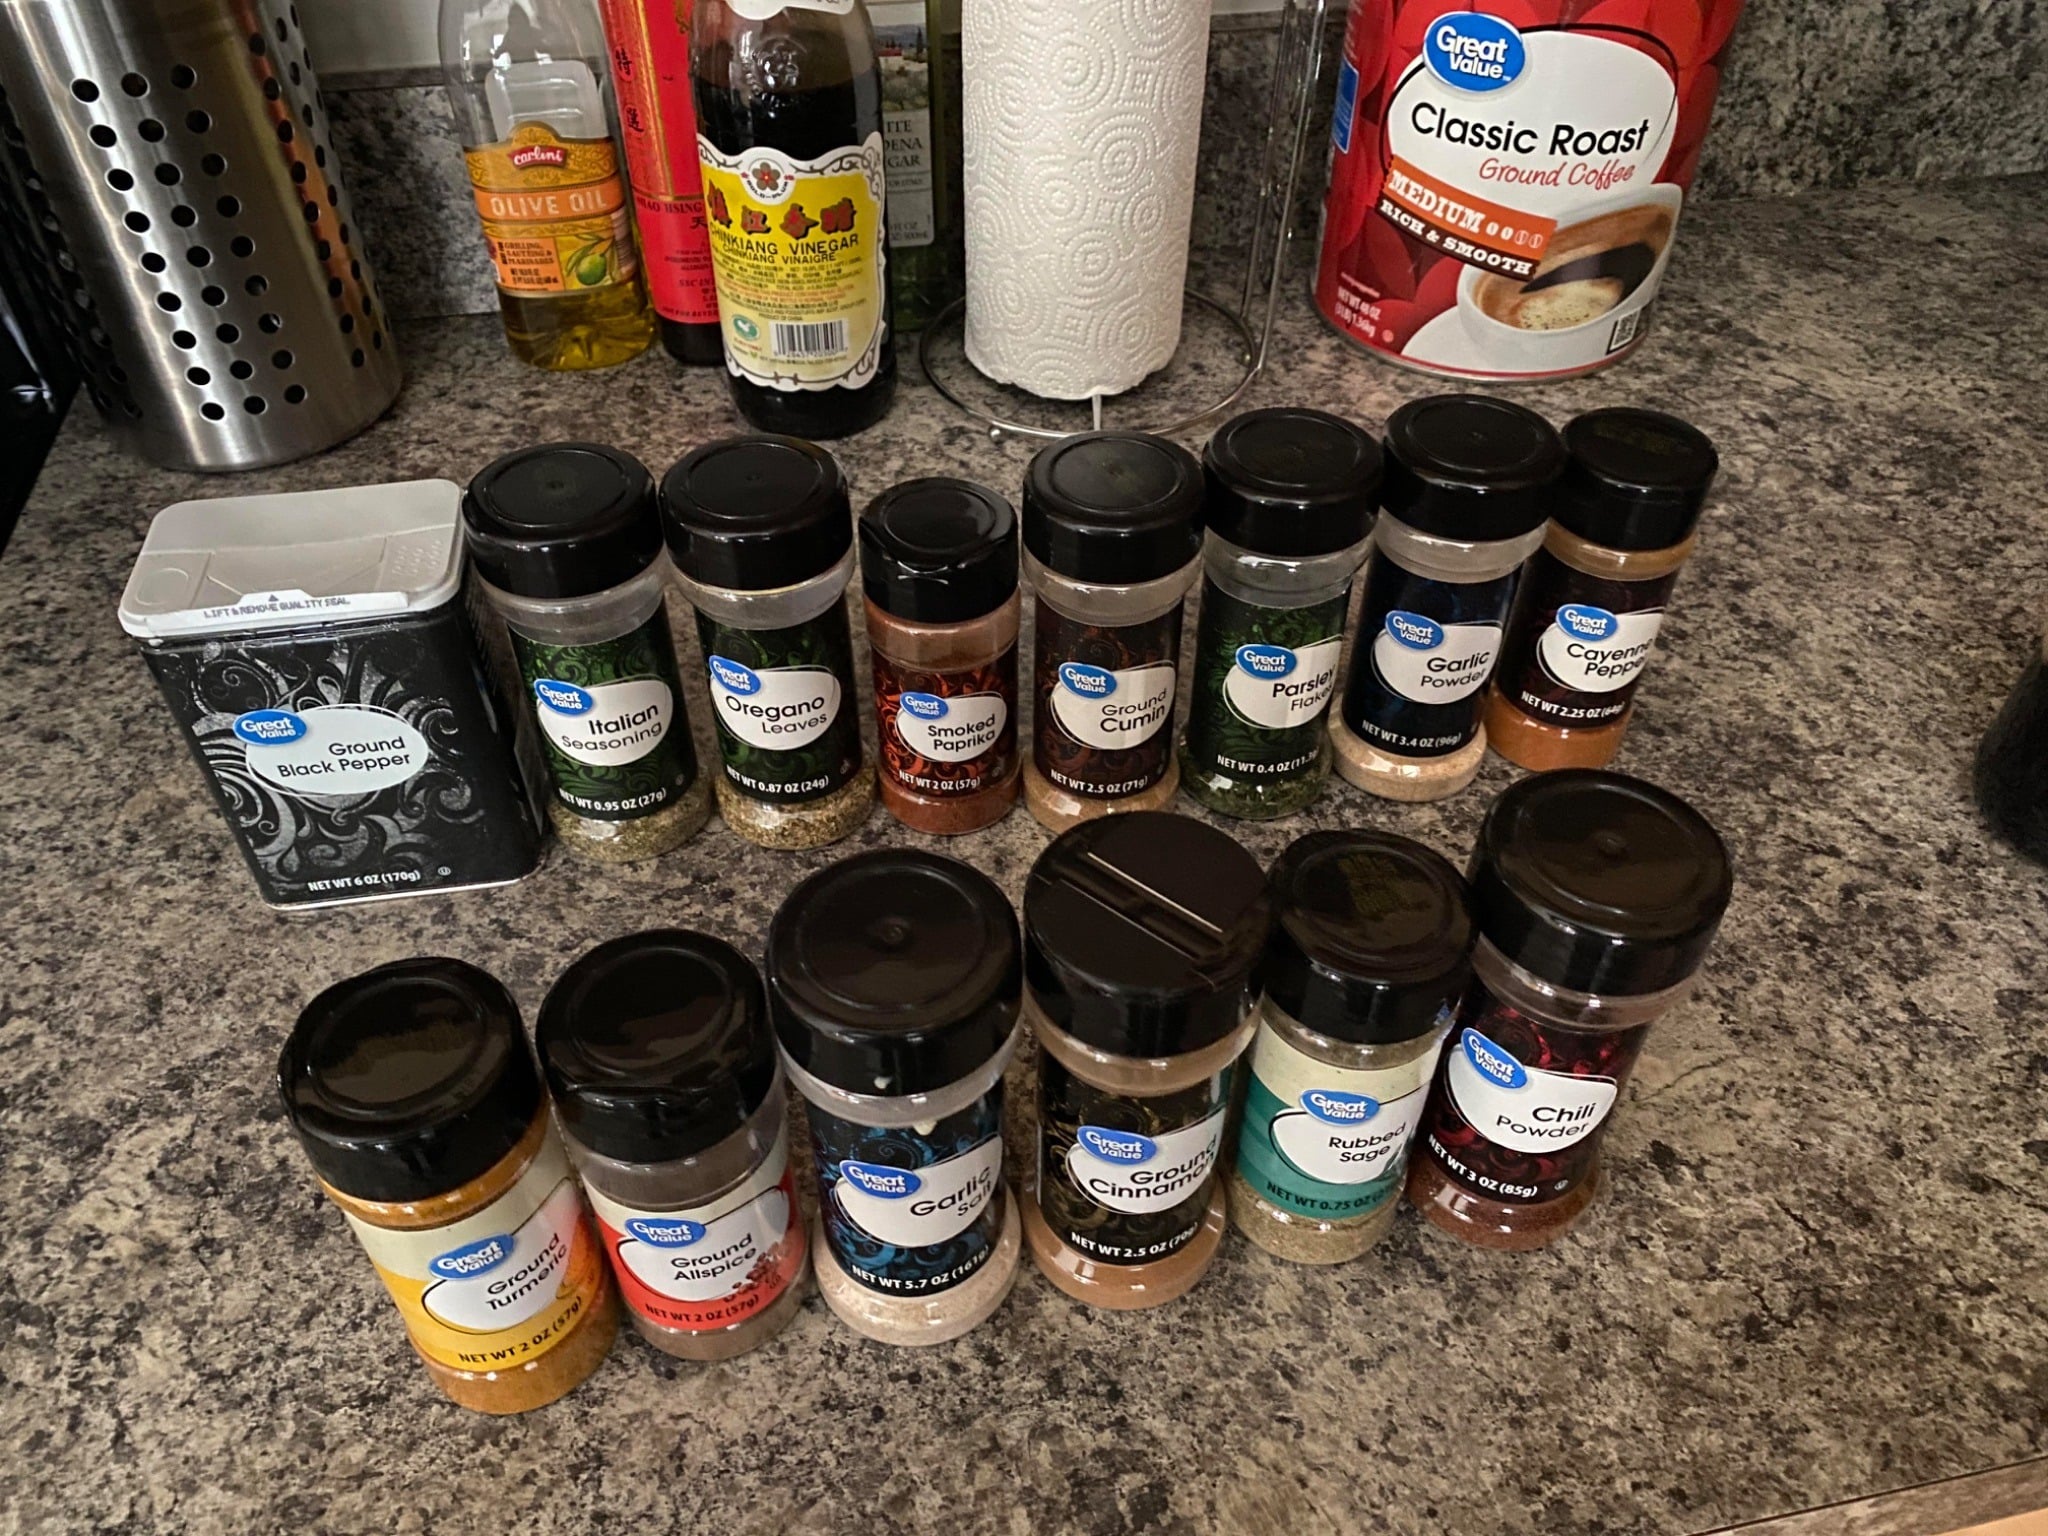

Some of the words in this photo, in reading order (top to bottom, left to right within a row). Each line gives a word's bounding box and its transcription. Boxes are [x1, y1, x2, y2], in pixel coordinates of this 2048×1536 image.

[1437, 25, 1508, 63] Great
[1450, 52, 1503, 78] Value
[1412, 102, 1538, 155] Classic
[1549, 118, 1649, 156] Roast
[1479, 157, 1567, 186] Ground
[1568, 159, 1635, 190] Coffee
[490, 196, 559, 216] OLIVE
[570, 191, 606, 212] OIL
[1388, 170, 1485, 234] MEDIUM
[711, 222, 778, 255] CHINKIANG
[789, 234, 858, 255] VINEGAR
[1380, 200, 1426, 235] RICH
[1426, 230, 1440, 243] &
[1443, 237, 1532, 275] SMOOTH
[782, 251, 835, 264] VINAIGRE
[204, 609, 229, 618] LIFT
[239, 604, 278, 615] REMOVE
[280, 599, 322, 611] QUALITY
[325, 597, 350, 607] SEAL
[1393, 616, 1434, 638] Great
[1565, 609, 1608, 629] Great
[1572, 622, 1605, 636] Value
[1401, 630, 1431, 645] Value
[1244, 651, 1286, 665] Great
[1252, 663, 1285, 672] Value
[1427, 652, 1490, 672] Garlic
[1584, 657, 1645, 679] Peppe
[713, 661, 750, 683] Great
[723, 675, 750, 690] Value
[1065, 668, 1106, 685] Great
[1421, 669, 1486, 688] Powder
[539, 684, 581, 702] Great
[1074, 681, 1106, 693] Value
[550, 697, 582, 709] Value
[726, 696, 824, 722] Oregano
[905, 696, 939, 710] Great
[913, 705, 939, 715] Value
[1102, 688, 1166, 715] Ground
[1521, 691, 1541, 707] NET
[1541, 701, 1559, 714] WT
[1560, 707, 1584, 718] 2.25
[1586, 708, 1602, 718] OZ
[241, 717, 293, 732] Great
[589, 705, 658, 735] Italian
[762, 714, 827, 734] Leaves
[928, 714, 995, 737] Smoked
[1100, 705, 1165, 732] Cumin
[257, 728, 296, 739] Value
[562, 722, 662, 750] Seasoning
[934, 730, 995, 752] Paprika
[1362, 720, 1380, 736] NET
[1380, 730, 1398, 743] WT
[1400, 736, 1417, 747] 3.4
[1420, 738, 1435, 747] OZ
[329, 736, 405, 756] Ground
[277, 761, 334, 777] Black
[339, 753, 410, 772] Pepper
[1217, 755, 1236, 769] NET
[1238, 761, 1256, 772] WT
[1257, 764, 1274, 773] 0.4
[1277, 761, 1291, 772] OZ
[726, 765, 741, 781] NET
[741, 777, 757, 788] WT
[759, 782, 781, 793] 0.87
[785, 783, 799, 793] OZ
[801, 775, 829, 792] (24g)
[899, 770, 915, 783] NET
[916, 778, 931, 788] WT
[932, 781, 939, 789] 2
[941, 781, 954, 790] OZ
[956, 776, 980, 790] (57g)
[1051, 769, 1068, 785] NET
[1069, 778, 1086, 791] WT
[1087, 784, 1104, 793] 2.5
[1107, 784, 1121, 793] OZ
[1123, 776, 1148, 792] (71g)
[559, 788, 575, 803] NET
[575, 796, 592, 809] WT
[595, 800, 619, 810] 0.95
[621, 798, 637, 809] OZ
[638, 788, 667, 807] (27g)
[308, 880, 331, 891] NET
[332, 878, 351, 888] WT
[354, 877, 362, 886] 6
[364, 875, 381, 884] OZ
[382, 870, 421, 884] (170g)
[1468, 1035, 1515, 1076] Great
[1475, 1051, 1512, 1083] Value
[1310, 1094, 1369, 1112] Great
[1322, 1108, 1365, 1119] Value
[1533, 1103, 1597, 1122] Chili
[1328, 1122, 1406, 1148] Rubbed
[1497, 1115, 1589, 1138] Powder
[1086, 1131, 1143, 1152] Great
[1100, 1146, 1142, 1159] Value
[1130, 1133, 1217, 1184] Ground
[1340, 1145, 1391, 1162] Sage
[849, 1166, 905, 1186] Great
[1089, 1154, 1214, 1198] Cinnamon
[1428, 1134, 1449, 1158] NET
[1447, 1156, 1467, 1175] WT
[1467, 1170, 1476, 1181] 3
[1479, 1176, 1499, 1190] OZ
[1499, 1183, 1538, 1197] (85g)
[862, 1181, 906, 1193] Value
[910, 1166, 990, 1216] Garlic
[1267, 1182, 1290, 1200] NET
[1293, 1197, 1318, 1208] WT
[1320, 1200, 1350, 1210] 0.75
[1354, 1195, 1371, 1208] OZ
[633, 1222, 691, 1235] Great
[649, 1232, 692, 1242] Value
[437, 1241, 501, 1270] Great
[671, 1234, 753, 1268] Ground
[1071, 1232, 1095, 1250] NET
[1098, 1245, 1121, 1257] WT
[1124, 1248, 1146, 1257] 2.5
[1149, 1243, 1167, 1255] OZ
[455, 1251, 504, 1273] Value
[487, 1233, 560, 1295] Ground
[674, 1248, 756, 1280] Allspice
[485, 1244, 568, 1310] Turmeric
[852, 1265, 876, 1283] NET
[879, 1277, 901, 1289] WT
[905, 1279, 928, 1289] 5.7
[931, 1273, 949, 1285] OZ
[645, 1304, 667, 1318] NET
[670, 1311, 690, 1322] WT
[695, 1314, 703, 1322] 2
[707, 1311, 724, 1321] OZ
[726, 1295, 759, 1317] (57g)
[458, 1353, 487, 1363] NET
[491, 1348, 515, 1361] WT
[522, 1342, 531, 1352] 2
[532, 1331, 552, 1345] OZ
[553, 1296, 582, 1332] (57g)
